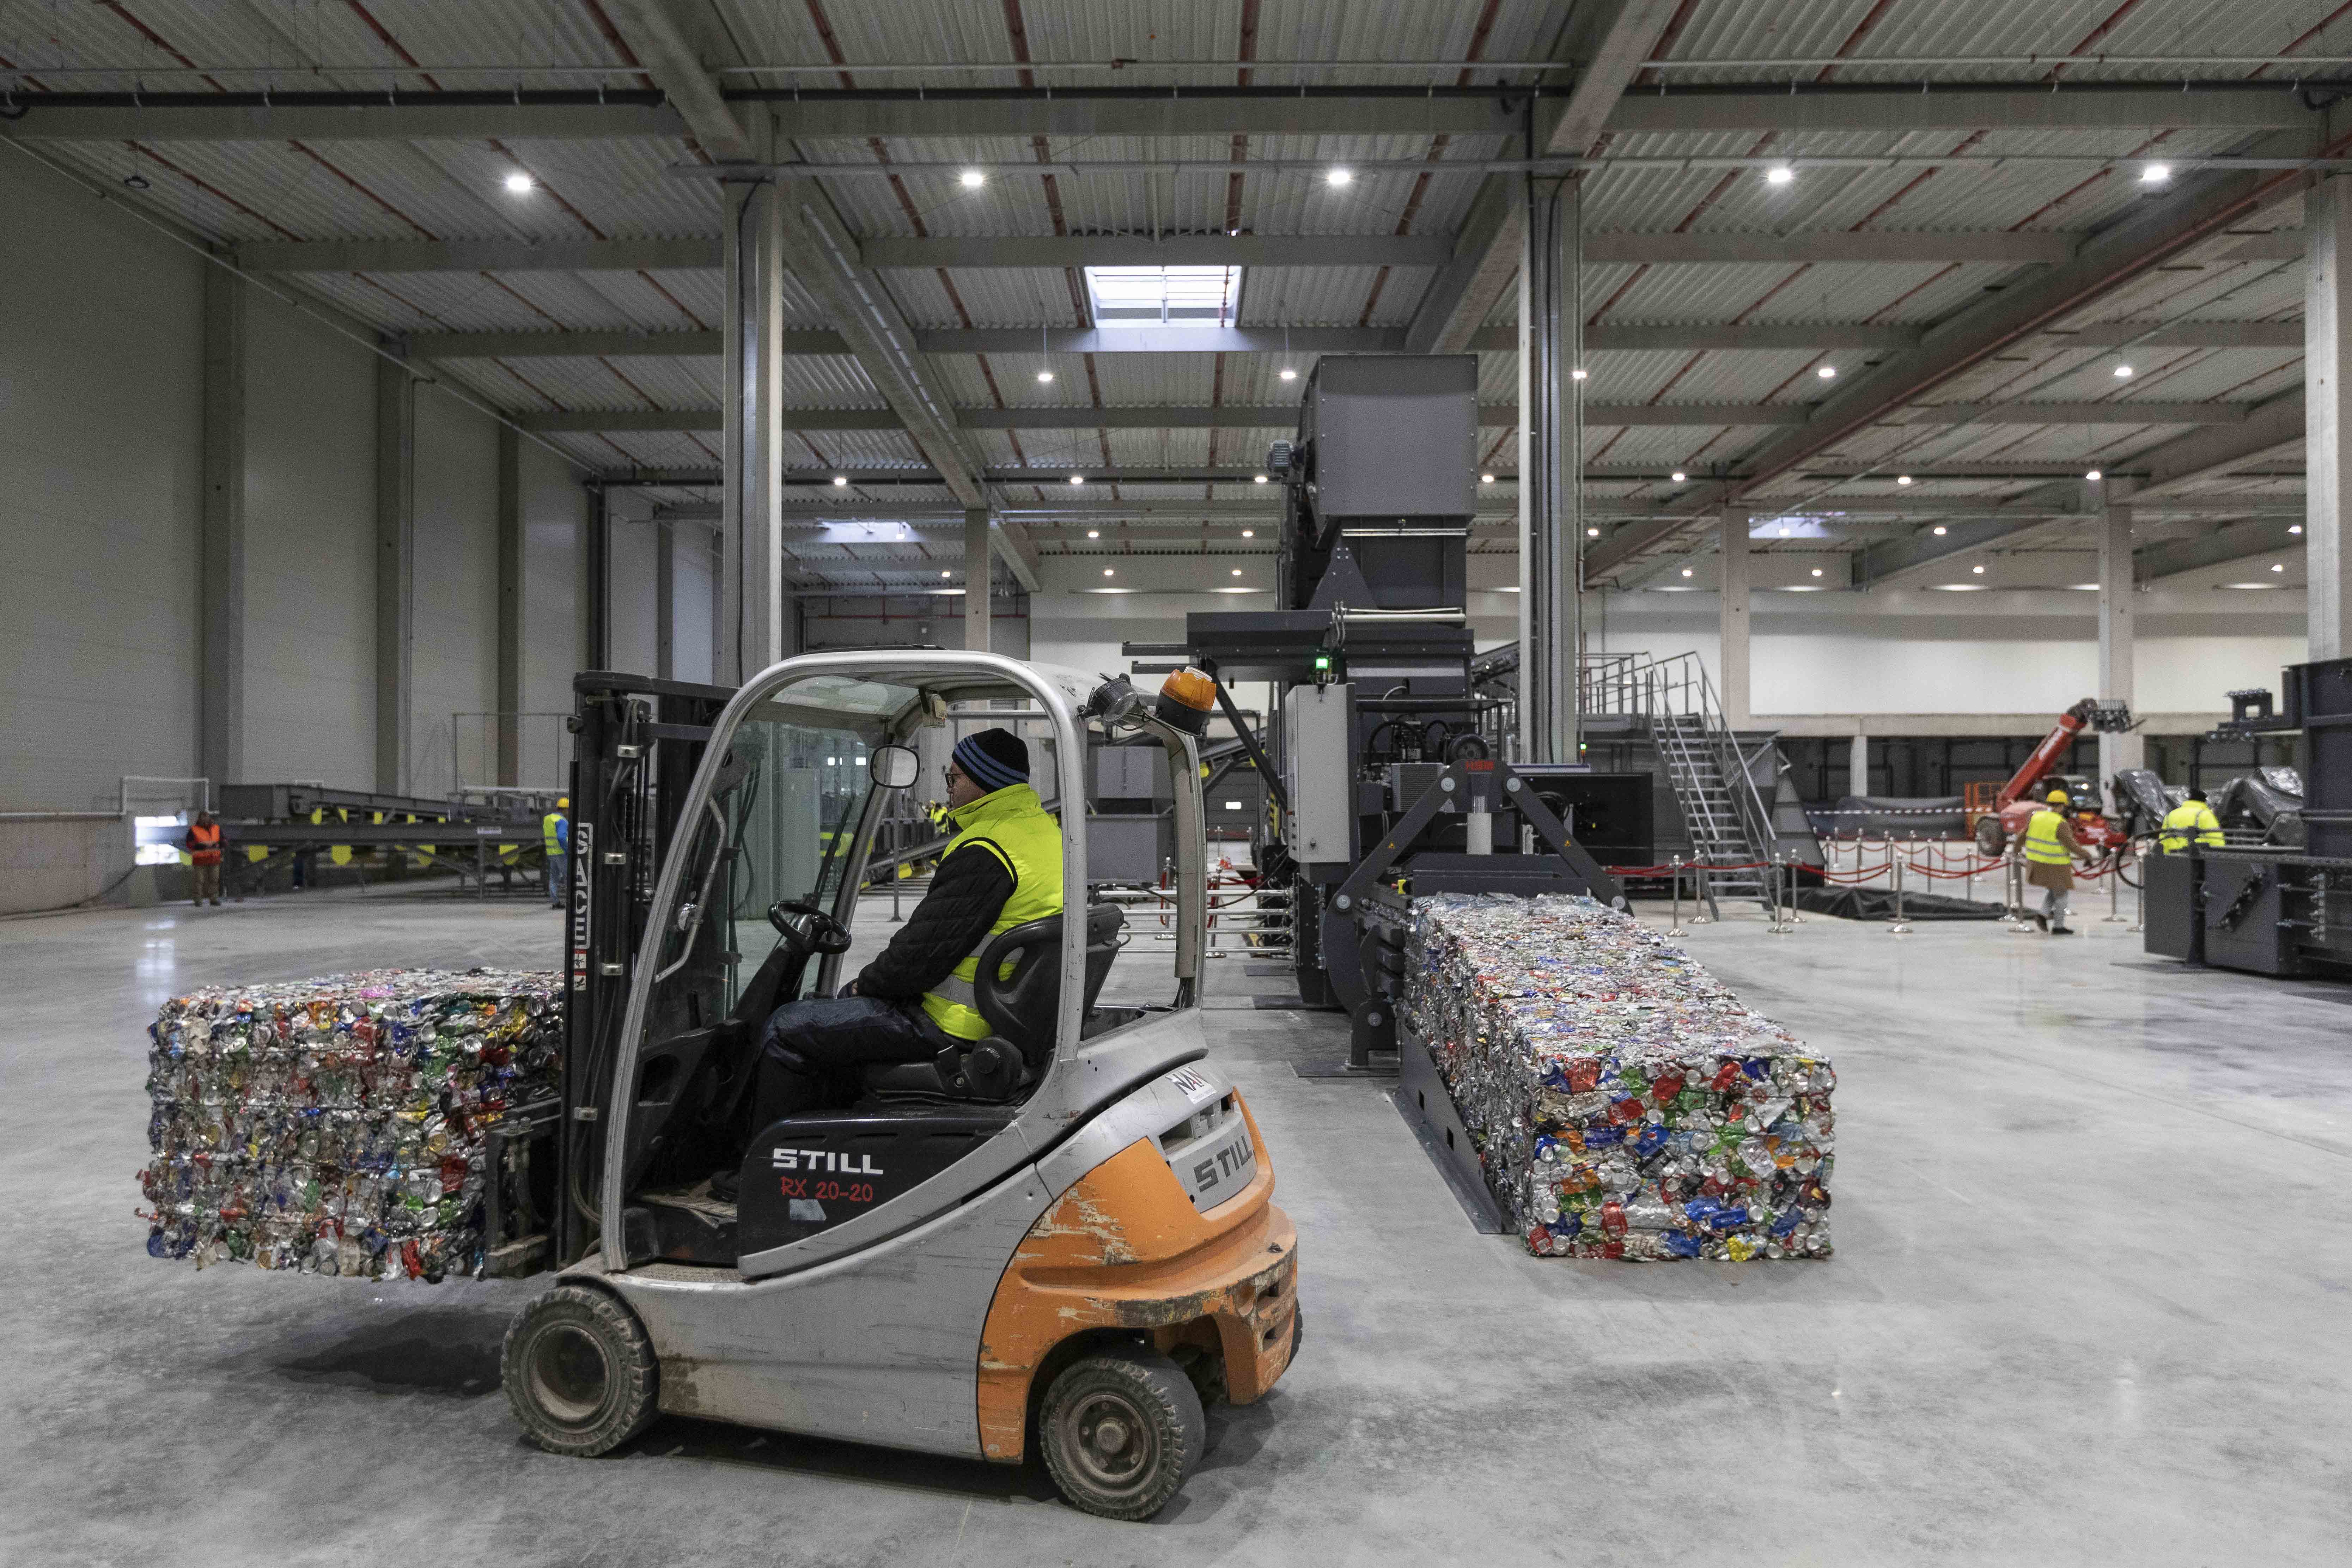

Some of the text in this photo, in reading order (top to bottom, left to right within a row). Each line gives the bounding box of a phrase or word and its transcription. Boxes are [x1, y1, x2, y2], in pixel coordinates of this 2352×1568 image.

[773, 1148, 883, 1174] STILL
[1193, 1136, 1253, 1192] STILL
[780, 1176, 873, 1201] RX 20-20
